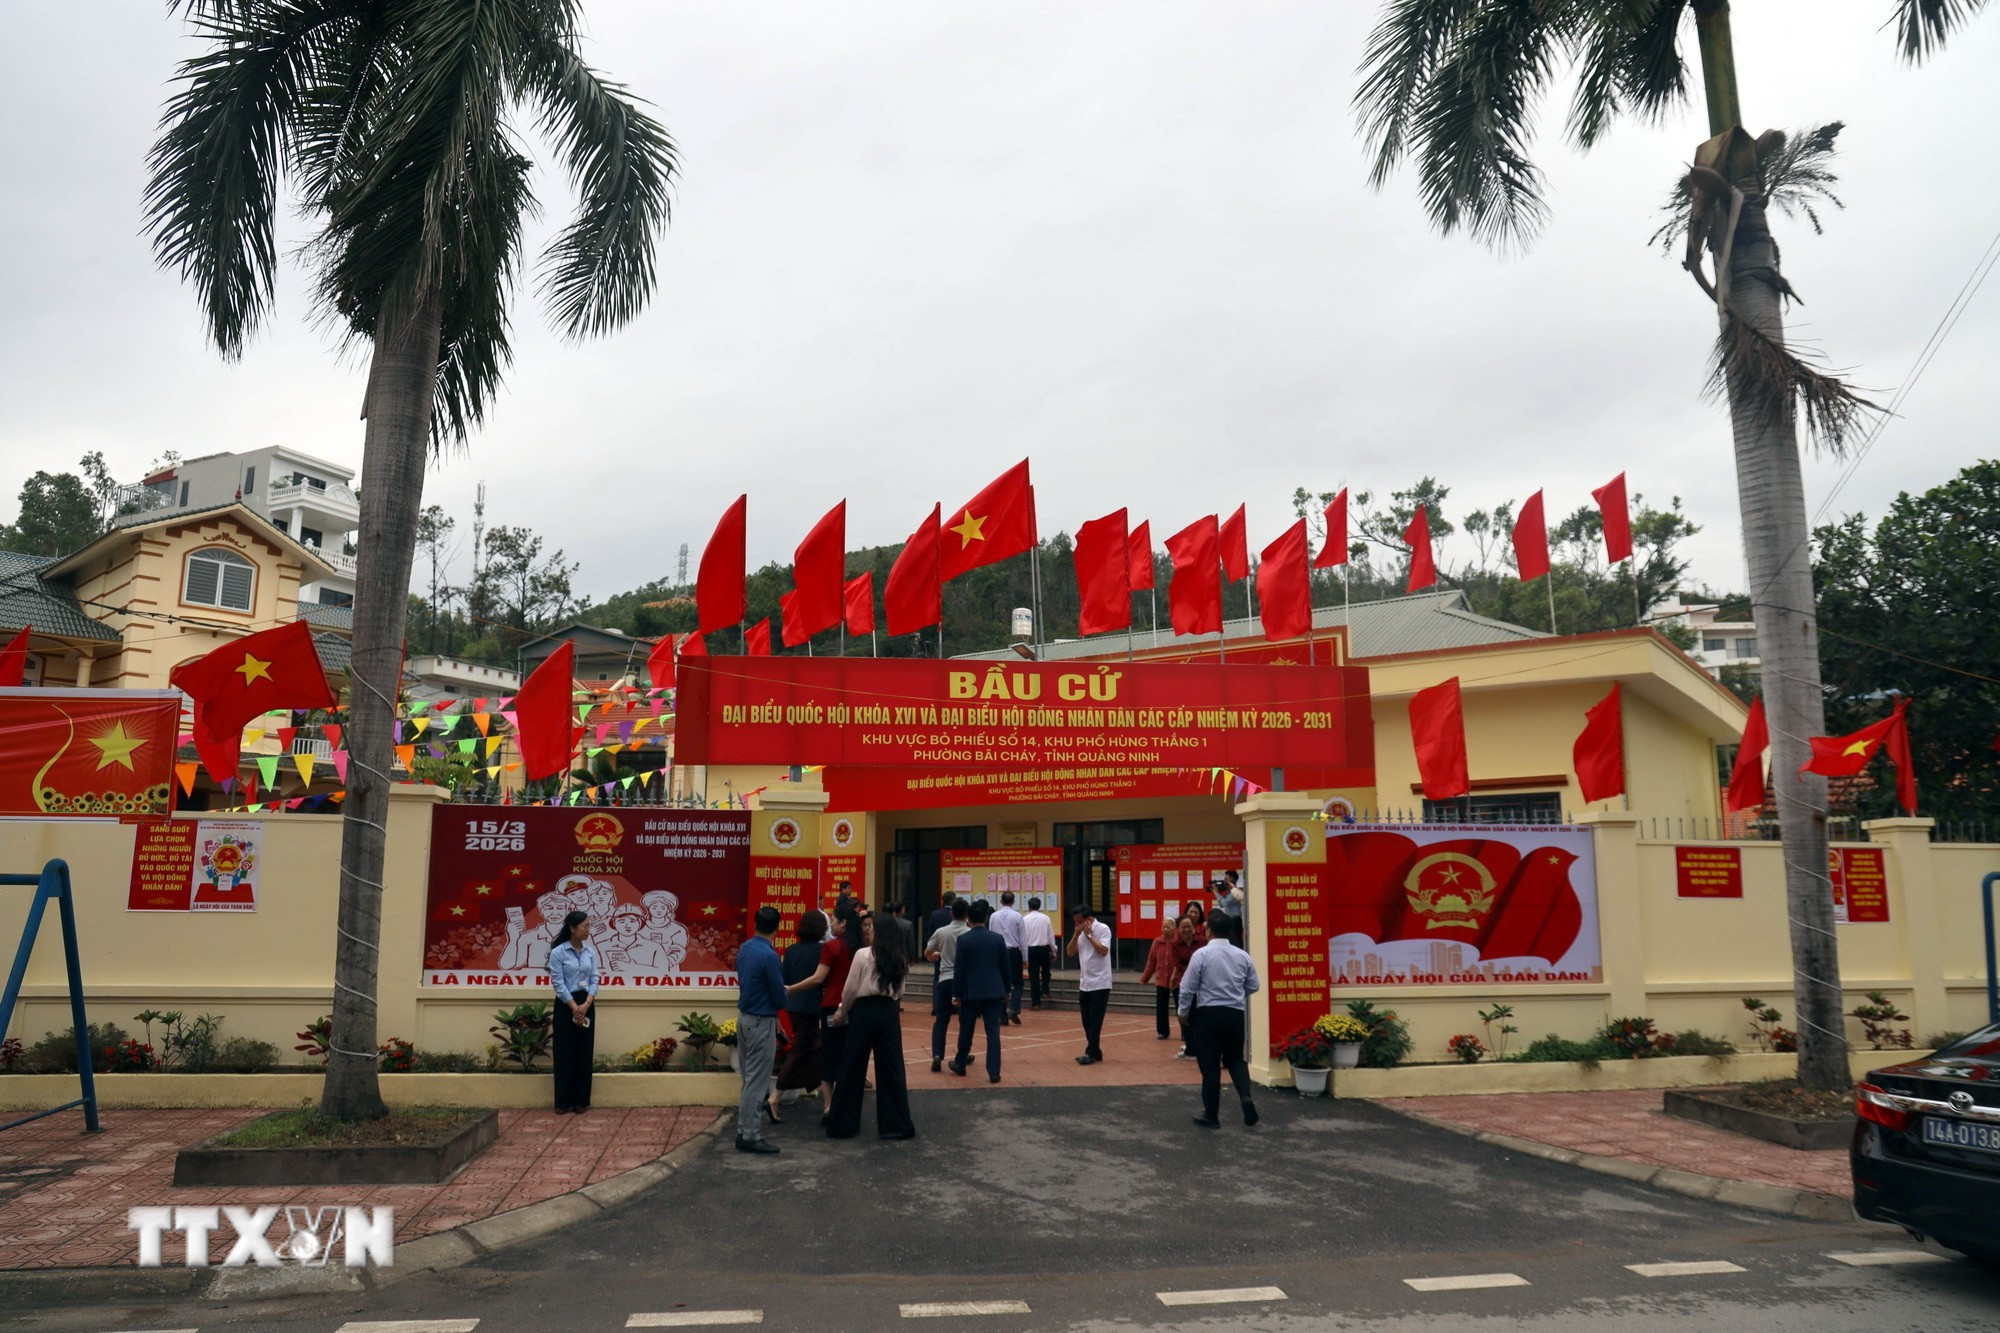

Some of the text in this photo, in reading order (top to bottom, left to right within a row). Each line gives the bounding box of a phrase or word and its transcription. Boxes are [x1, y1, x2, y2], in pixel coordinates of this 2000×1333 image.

[950, 663, 1122, 701] BẦU CỬ
[723, 705, 746, 727] ĐẠI
[751, 698, 782, 723] BIỂU
[787, 700, 822, 725] QUỐC
[828, 702, 850, 728] HỘI
[854, 703, 890, 724] KHÓA
[894, 707, 916, 725] XVI
[920, 704, 938, 725] VÀ
[941, 708, 963, 729] ĐẠI
[968, 702, 998, 726] BIỂU
[1002, 706, 1024, 730] HỘI
[1028, 704, 1064, 727] ĐỒNG
[1068, 706, 1104, 728] NHÂN
[1108, 707, 1134, 728] DÂN
[1139, 706, 1164, 728] CÁC
[1168, 704, 1193, 728] CẤP
[1198, 707, 1238, 731] NHIỆM
[1242, 708, 1258, 728] KỲ
[1262, 712, 1291, 728] 2026
[1304, 712, 1332, 728] 2031
[862, 732, 1207, 748] KHU VỰC BỎ PHIẾU SỐ 14, KHU PHỐ HÙNG THẮNG 1
[914, 750, 1160, 763] PHƯỜNG BÃI CHÁY, TỈNH QUẢNG NINH
[150, 824, 190, 833] SÁNG SUỐT
[466, 821, 526, 835] 15/3
[645, 818, 746, 833] BẦU CỬ ĐẠI BIỂU QUỐC HỘI KHÓA XVI
[466, 838, 526, 850] 2026
[636, 834, 644, 844] VÀ
[645, 836, 655, 846] ĐẠI
[656, 833, 670, 844] BIỂU
[670, 834, 680, 846] HỘI
[682, 834, 698, 845] ĐỒNG
[698, 835, 715, 845] NHÂN
[716, 834, 728, 846] DÂN
[729, 836, 740, 846] CÁC
[138, 853, 148, 861] ĐỦ
[150, 853, 168, 862] ĐỨC,
[170, 853, 179, 862] ĐỦ
[573, 854, 624, 864] QUỐC HỘI
[664, 847, 682, 859] NHIỆM
[684, 847, 692, 858] KỲ
[692, 850, 706, 858] 2026
[712, 850, 725, 858] 2031
[156, 863, 174, 872] QUỐC
[177, 864, 190, 872] HỘI
[572, 864, 602, 874] KHÓA
[756, 866, 812, 880] NHIỆT LIỆT CHÀO MỪNG
[152, 873, 164, 882] HỘI
[166, 872, 186, 880] ĐỒNG
[142, 882, 182, 890] NHÂN DÂN!
[767, 882, 801, 896] NGÀY BẦU CỬ
[783, 900, 796, 914] QUỐC
[797, 901, 806, 916] HỘI
[786, 920, 794, 930] XVI
[775, 938, 783, 950] ĐẠI
[432, 972, 458, 986] LÀ
[466, 972, 528, 986] NGÀY
[632, 974, 691, 986] TOÀN
[1329, 970, 1588, 985] LÀ NGÀY HỘI CỦA TOÀN DÂN!
